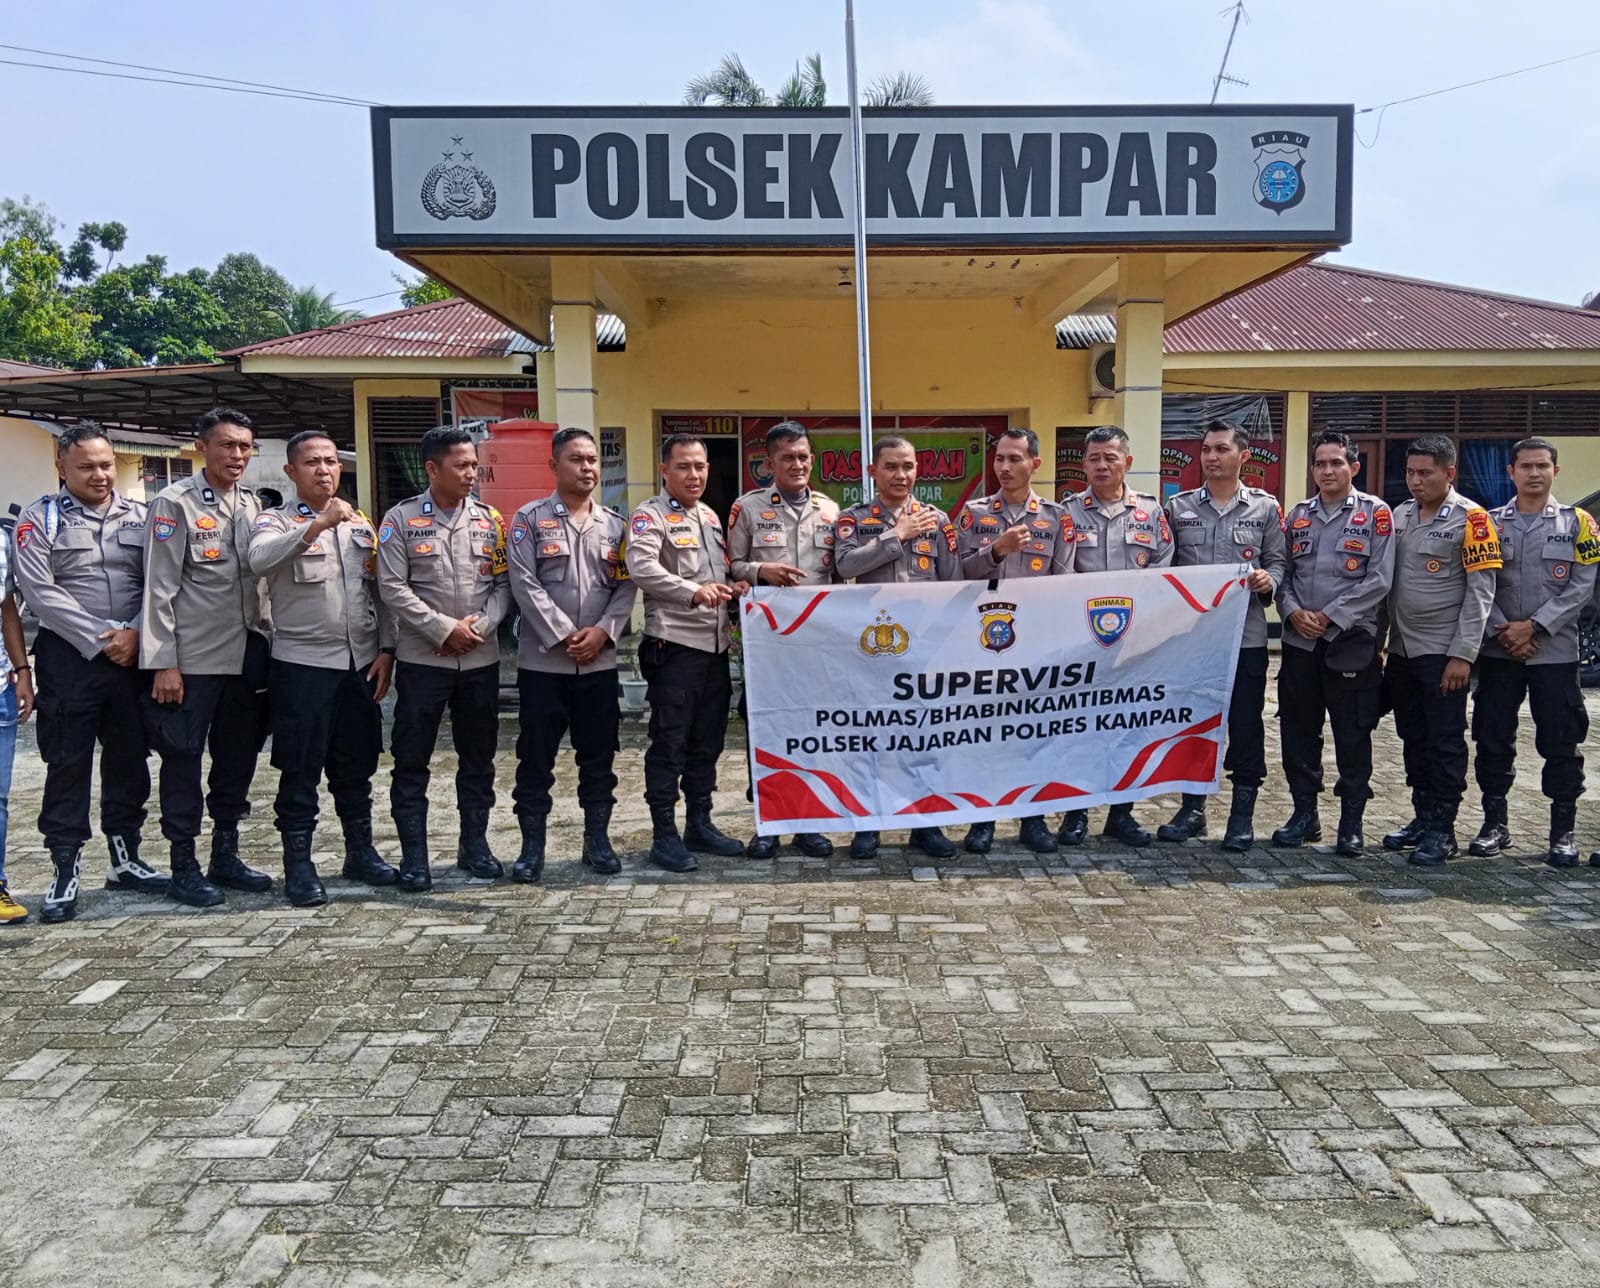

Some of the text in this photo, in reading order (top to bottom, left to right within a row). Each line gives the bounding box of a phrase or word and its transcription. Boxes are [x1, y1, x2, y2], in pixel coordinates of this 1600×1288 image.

[1258, 133, 1304, 145] RIAU
[530, 131, 1218, 221] POLSEK KAMPAR
[705, 418, 734, 434] 110
[600, 442, 621, 457] TAS
[1162, 447, 1193, 464] OPAM
[912, 486, 942, 501] MPAR
[407, 529, 437, 538] PAHRI
[1128, 523, 1154, 532] POLRI
[1343, 527, 1370, 537] POLRI
[195, 530, 222, 541] FEBRI
[472, 530, 498, 541] POLR
[1427, 531, 1454, 540] POLRI
[981, 604, 1014, 612] RIAU
[1094, 599, 1126, 607] BINMAS
[892, 661, 1097, 701] SUPERVISI
[815, 684, 1166, 728] POLMAS/BHABINKAMTIBMAS
[786, 706, 1194, 755] POLSEK JAJARAN POLRES KAMPAR
